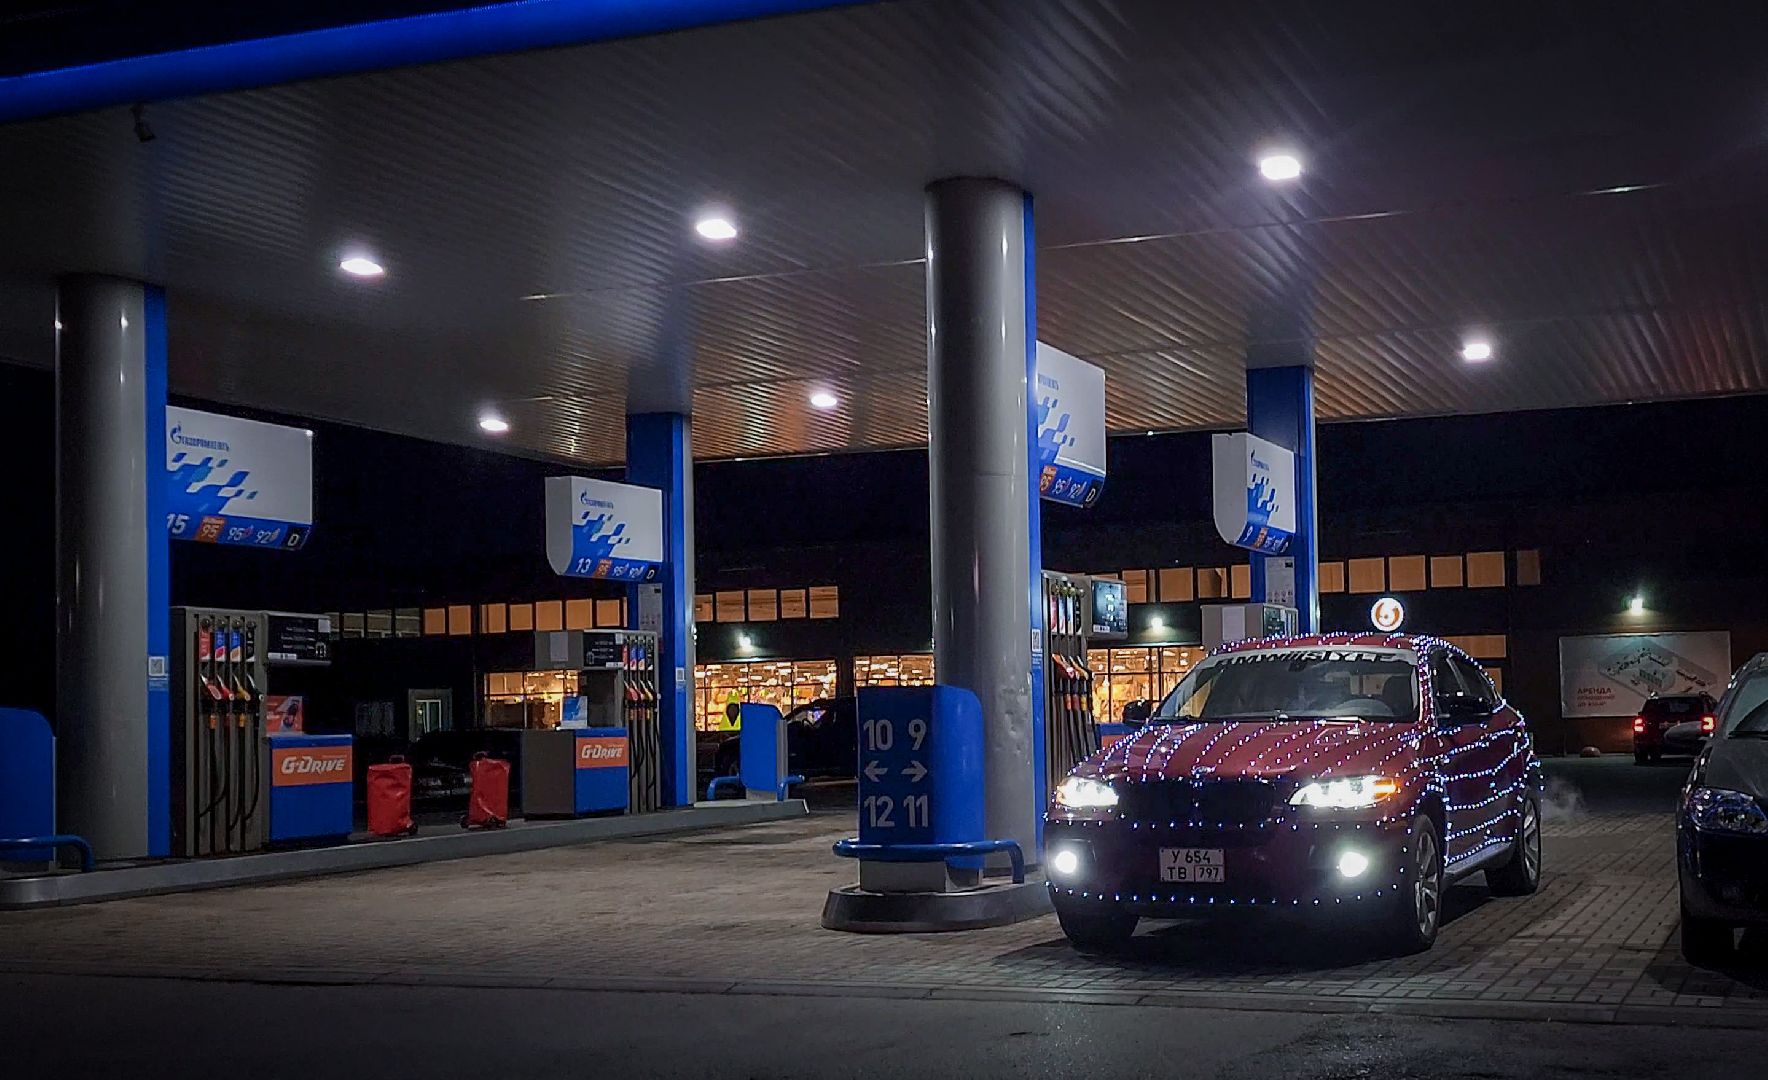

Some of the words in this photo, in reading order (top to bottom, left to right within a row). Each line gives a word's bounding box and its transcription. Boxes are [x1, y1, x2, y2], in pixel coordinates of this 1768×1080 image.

[167, 513, 190, 534] 15
[227, 527, 245, 541] 95
[255, 531, 271, 544] 92
[576, 558, 592, 574] 13
[863, 719, 894, 751] 10
[908, 718, 927, 751] 9
[863, 795, 895, 828] 12
[903, 794, 929, 828] 11
[1185, 850, 1211, 864] 654
[1167, 867, 1187, 880] ТВ
[1199, 867, 1219, 879] 797
